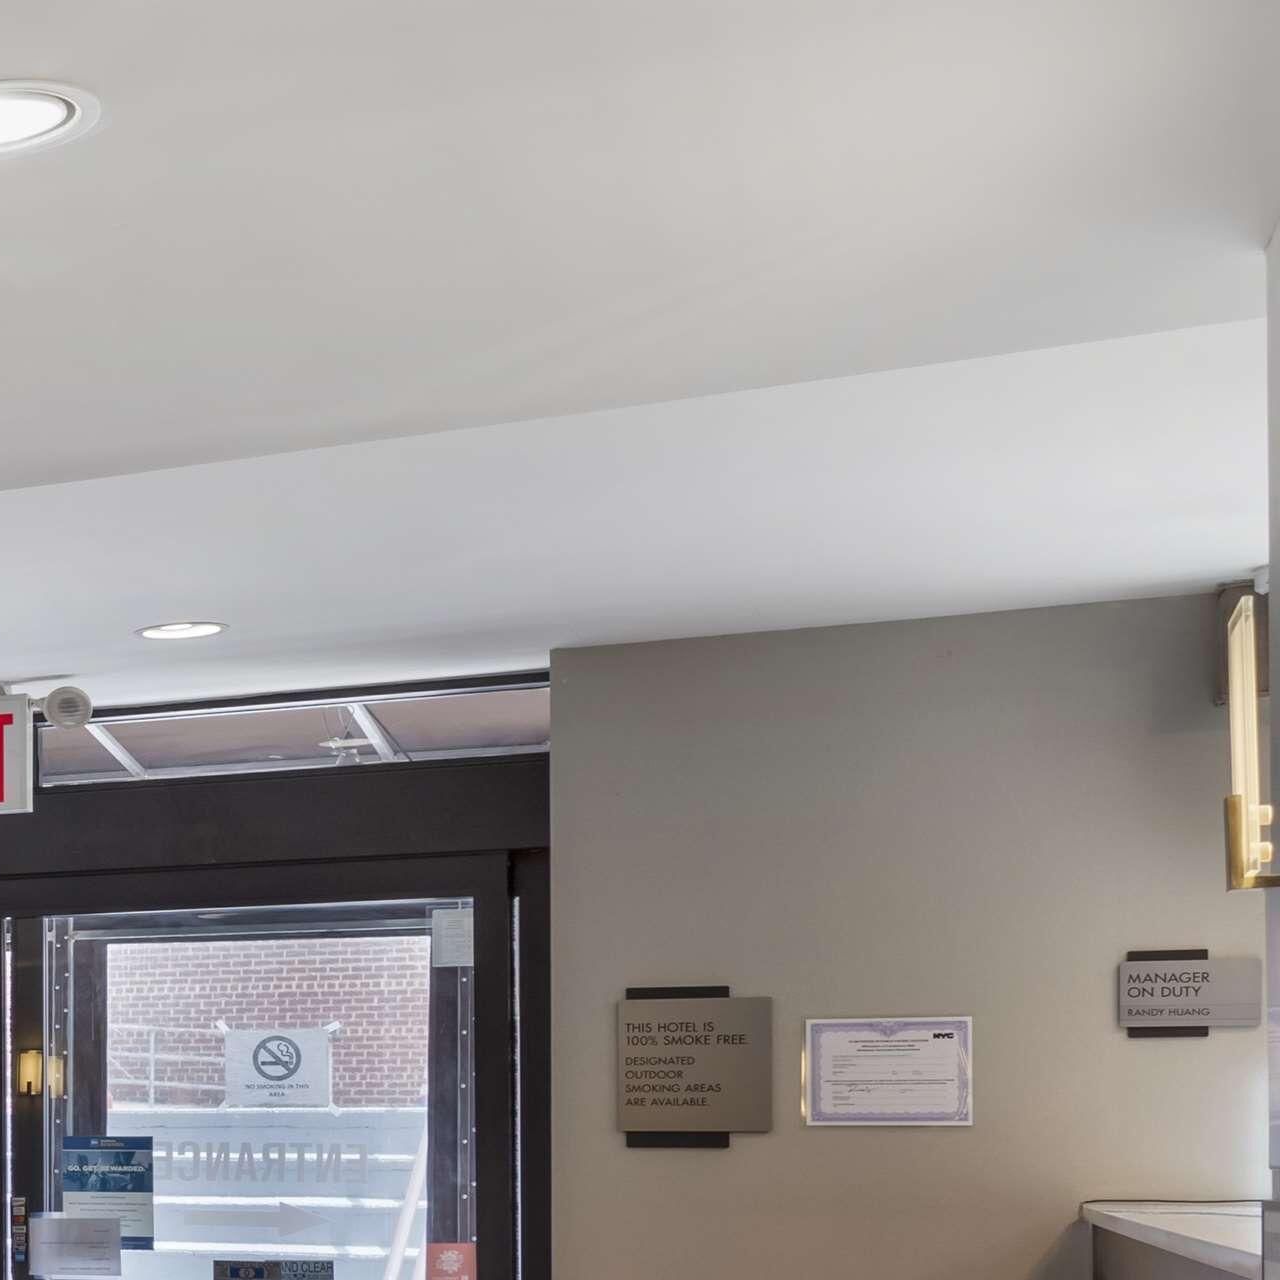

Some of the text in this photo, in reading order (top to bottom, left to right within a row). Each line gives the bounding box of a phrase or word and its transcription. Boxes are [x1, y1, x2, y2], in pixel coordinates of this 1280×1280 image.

[1128, 972, 1210, 983] MANAGER
[1128, 986, 1201, 998] ON DUTY
[1127, 1008, 1210, 1016] RANDY HUANG
[625, 1022, 714, 1033] THIS HOTEL IS
[627, 1035, 658, 1046] 100%
[663, 1035, 711, 1046] SMOKE
[625, 1057, 695, 1066] DESIGNATED
[625, 1070, 684, 1079] OUTDOOR
[625, 1083, 722, 1093] SMOKING AREAS
[625, 1097, 646, 1107] ARE
